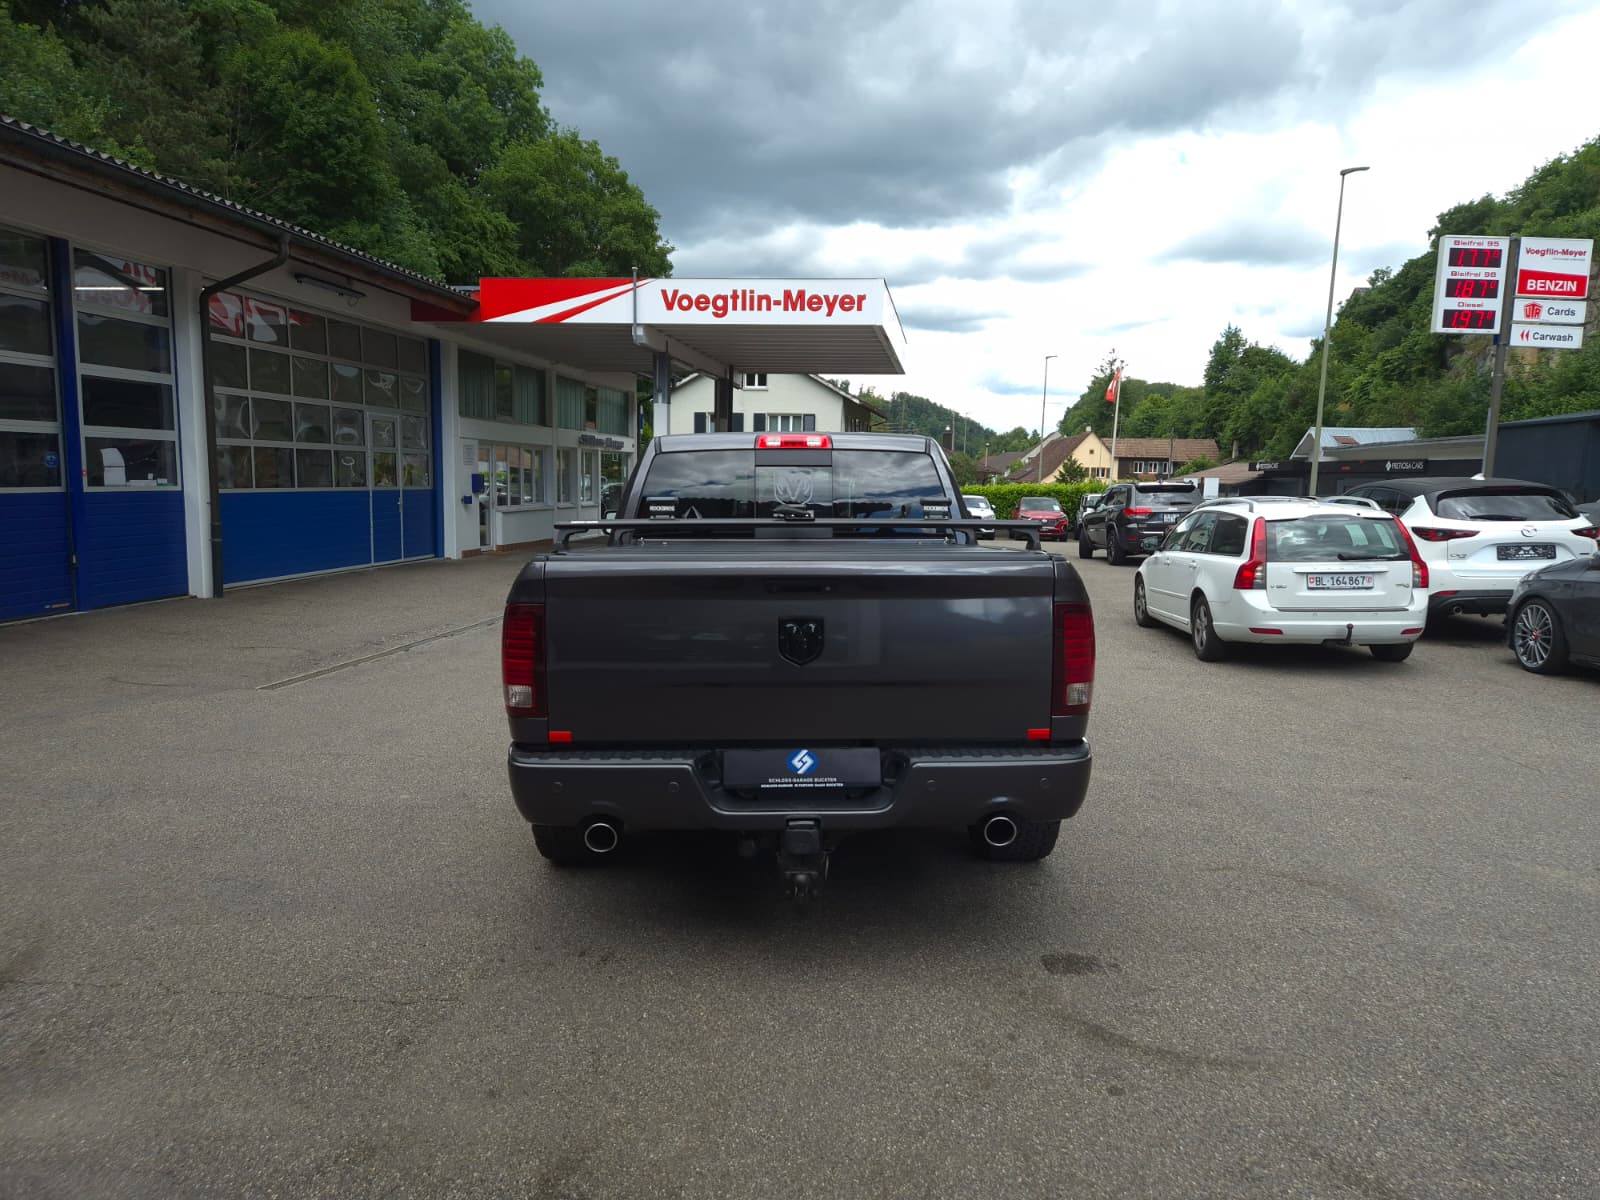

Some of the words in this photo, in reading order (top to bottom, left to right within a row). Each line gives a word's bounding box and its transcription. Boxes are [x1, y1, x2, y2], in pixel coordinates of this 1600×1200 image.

[1525, 247, 1587, 258] Voegtlin-Meyer
[1526, 279, 1577, 292] BENZIN
[660, 289, 867, 319] Voegtlin-Meyer
[1547, 306, 1576, 317] Cards
[1532, 331, 1574, 342] Carwash
